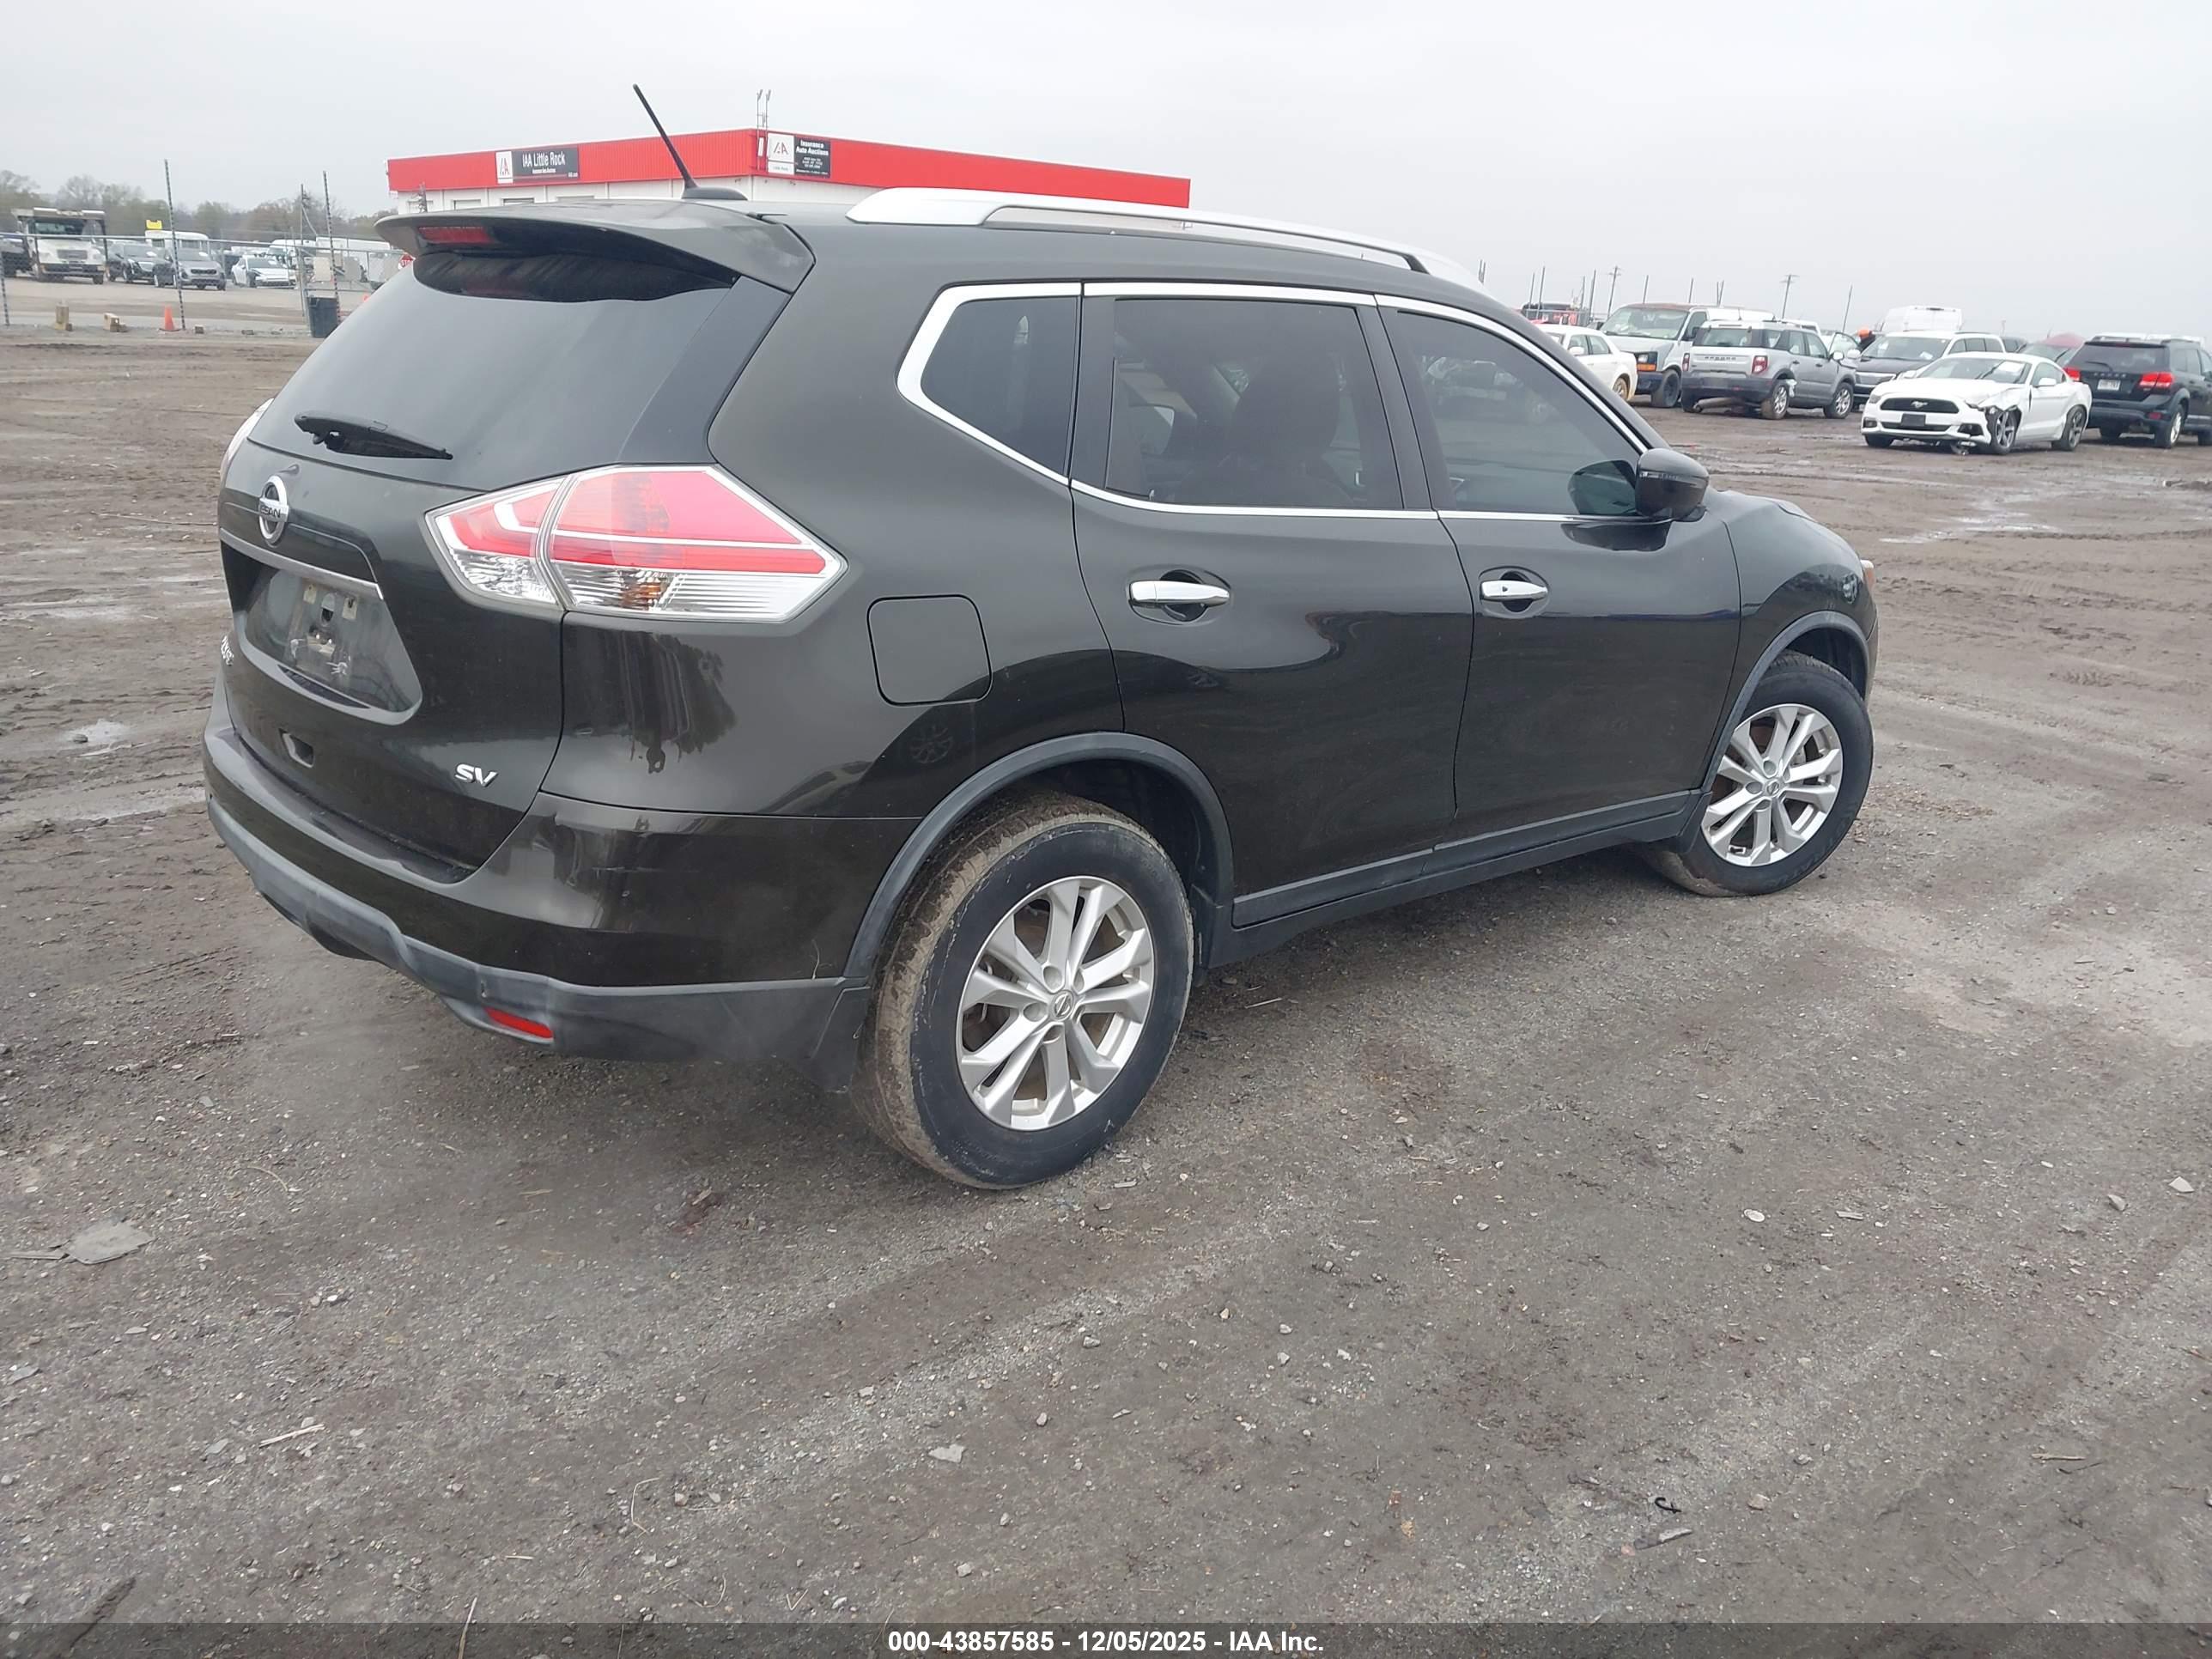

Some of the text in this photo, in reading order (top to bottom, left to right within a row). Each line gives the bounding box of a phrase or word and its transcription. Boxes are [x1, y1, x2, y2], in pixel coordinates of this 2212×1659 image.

[523, 151, 566, 167] IAA Little Rock
[455, 763, 498, 787] SV
